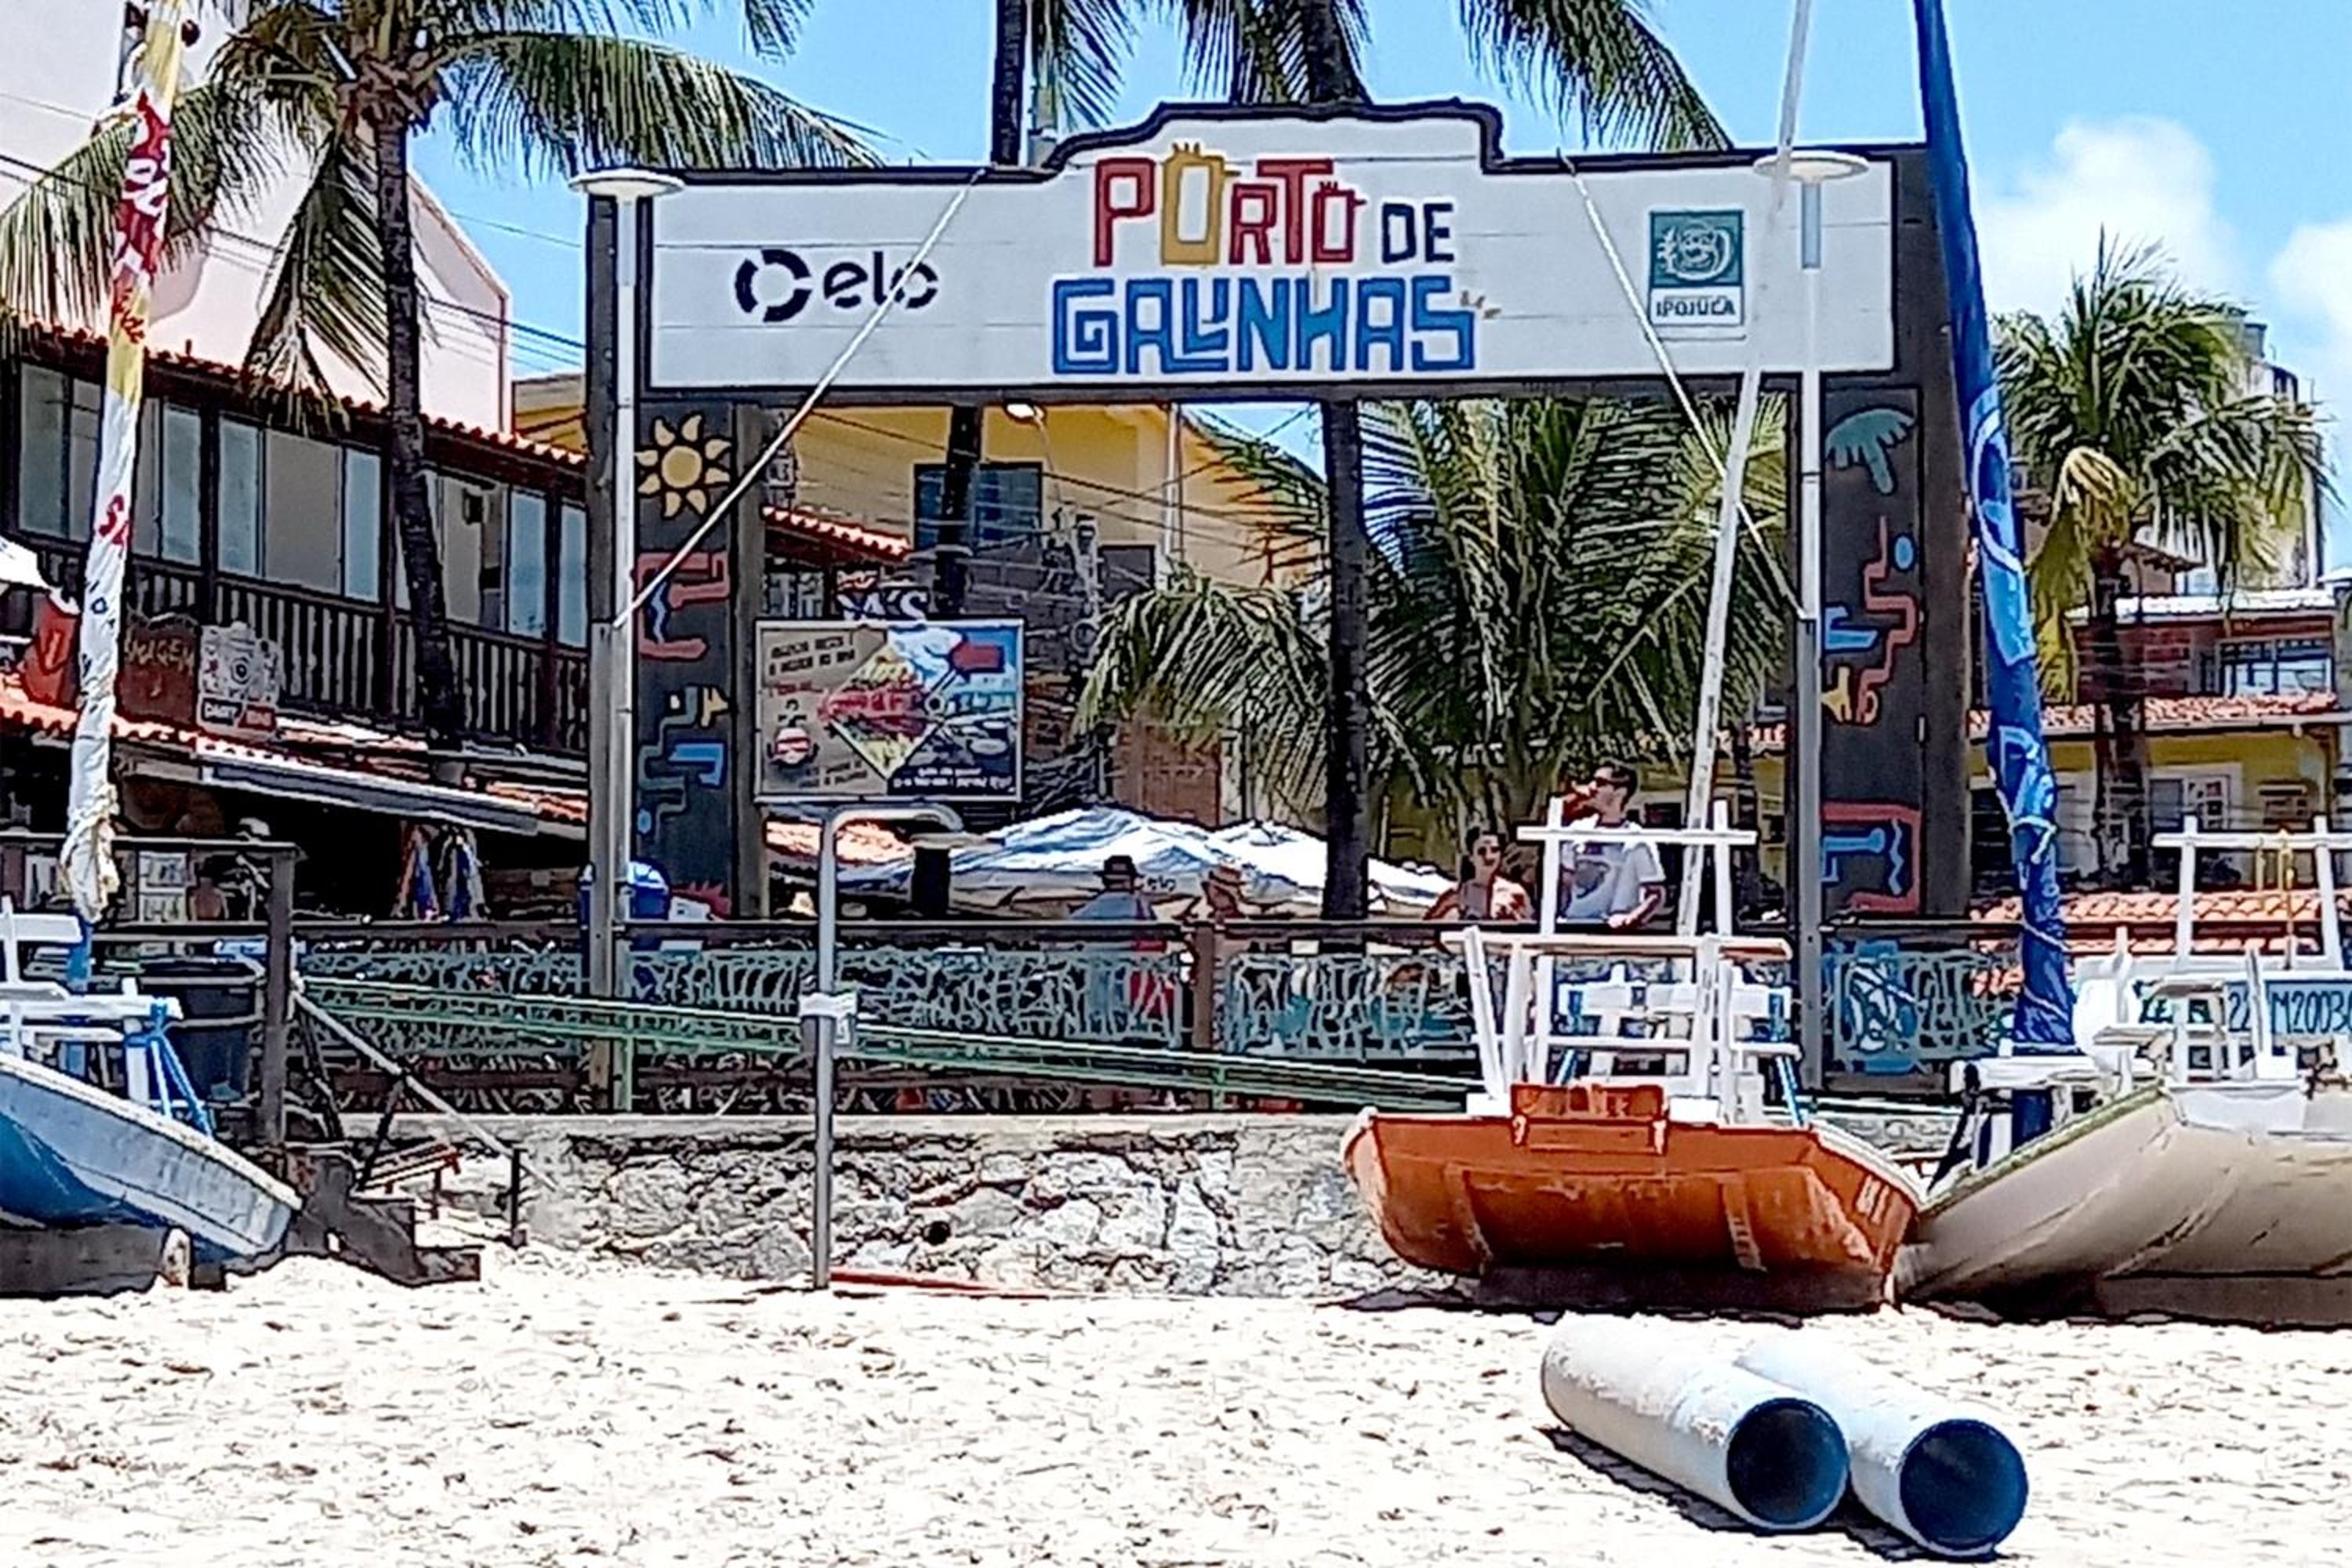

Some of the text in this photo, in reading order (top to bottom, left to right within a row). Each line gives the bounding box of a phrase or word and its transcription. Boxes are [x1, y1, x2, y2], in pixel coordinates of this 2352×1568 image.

[1094, 146, 1454, 267] PORTO DE
[823, 250, 939, 310] elo
[1656, 298, 1736, 318] IPOJUCA
[1052, 274, 1476, 376] GALINHAS
